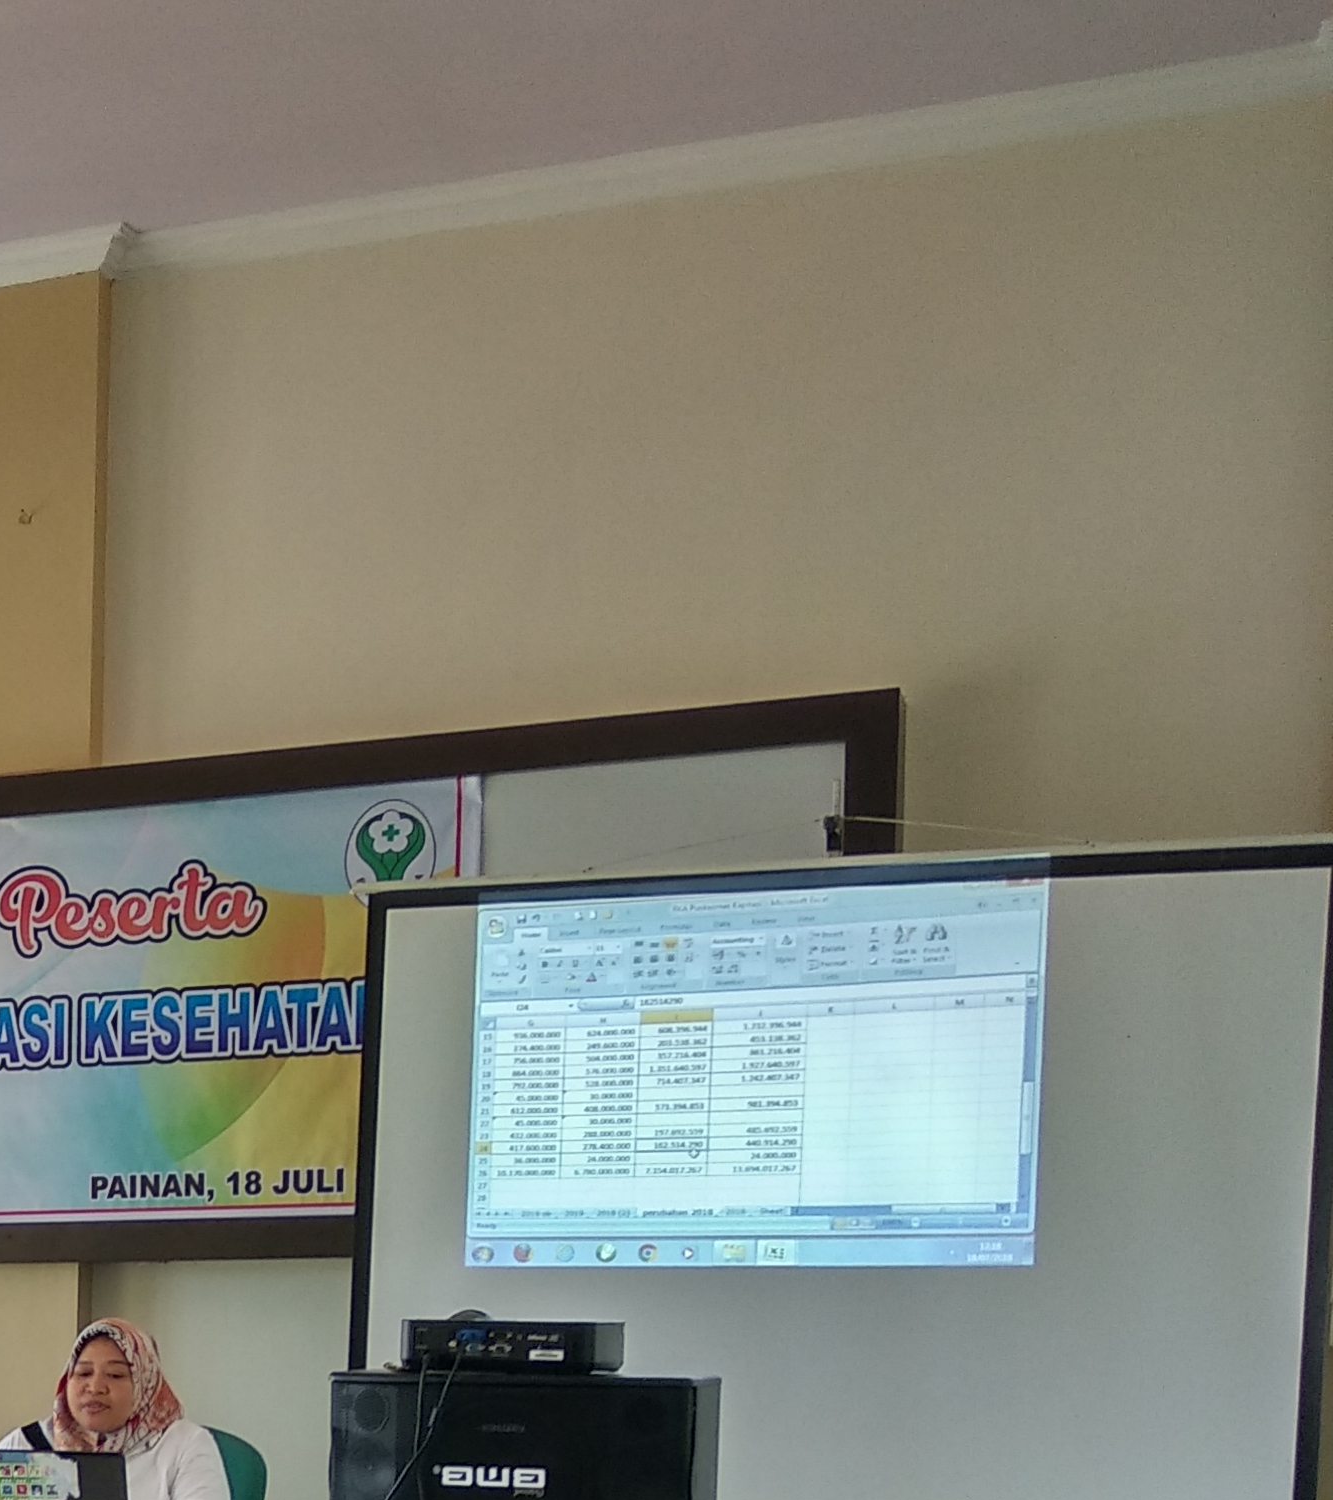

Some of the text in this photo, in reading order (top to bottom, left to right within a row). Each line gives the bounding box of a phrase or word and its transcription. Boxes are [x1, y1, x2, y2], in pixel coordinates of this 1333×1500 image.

[90, 1168, 345, 1202] PAINAN, 18 JULI
